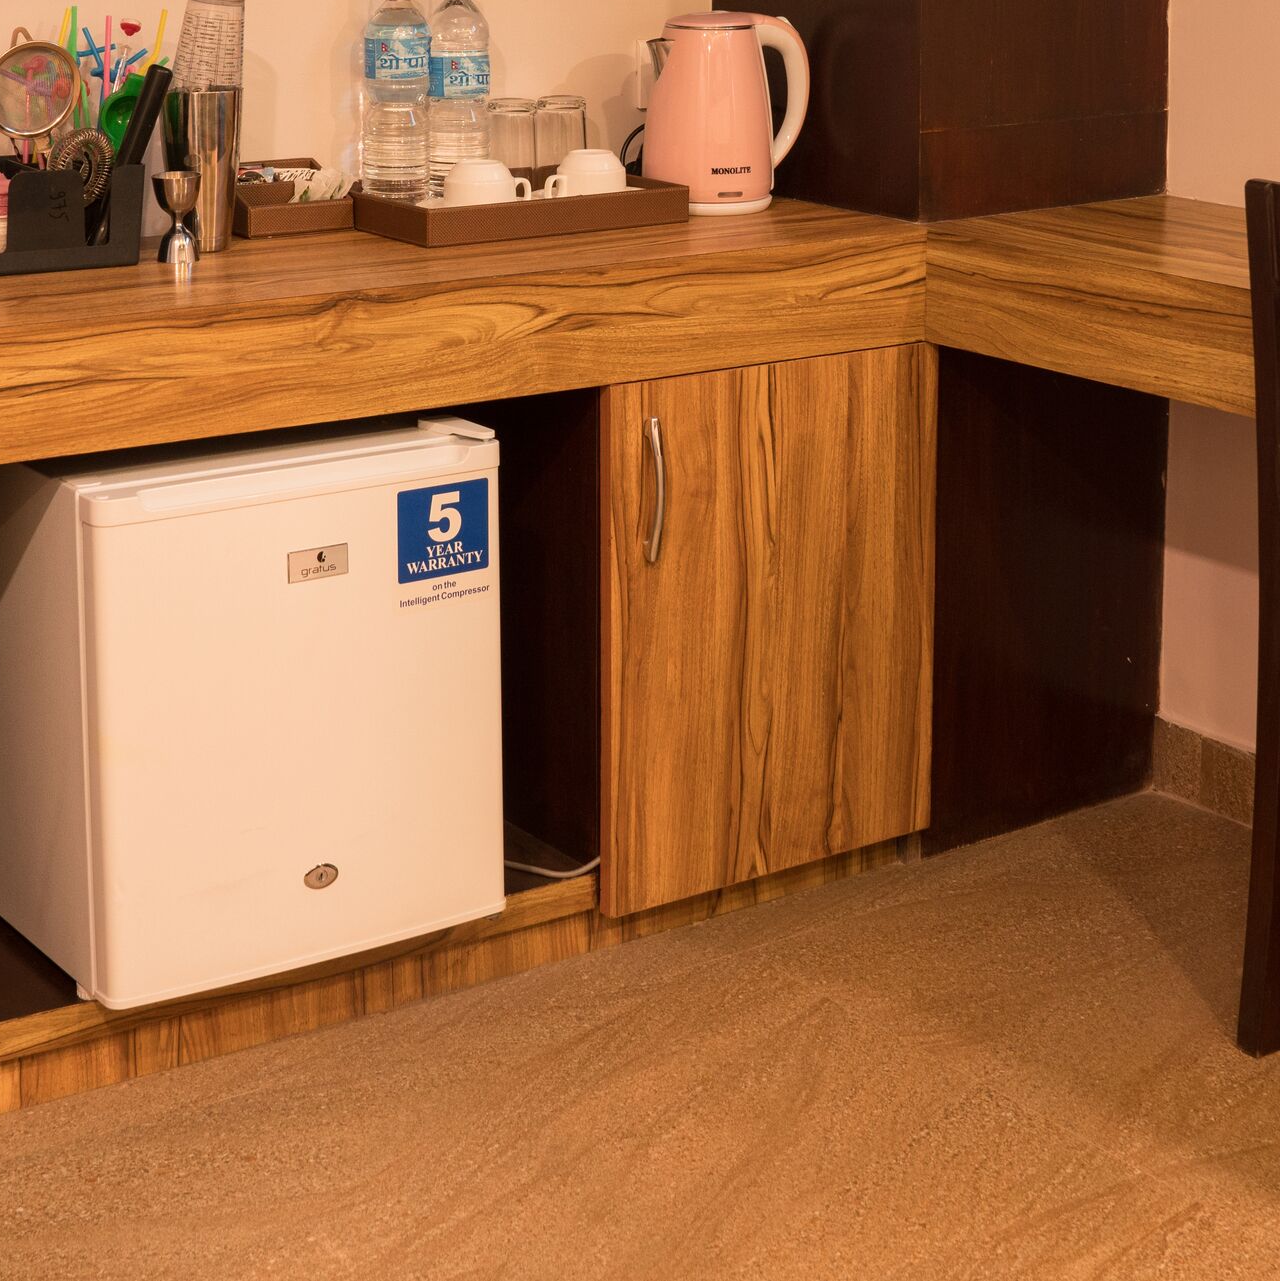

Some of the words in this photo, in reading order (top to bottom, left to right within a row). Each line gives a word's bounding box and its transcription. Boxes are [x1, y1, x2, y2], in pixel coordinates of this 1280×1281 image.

[711, 166, 751, 175] MONOLITE
[427, 491, 462, 543] 5
[426, 541, 463, 558] YEAR
[301, 562, 337, 578] gratus
[406, 550, 483, 574] WARRANTY
[432, 582, 443, 591] on
[443, 580, 457, 589] the
[399, 593, 440, 608] Intelligent
[441, 584, 490, 601] Compressor
